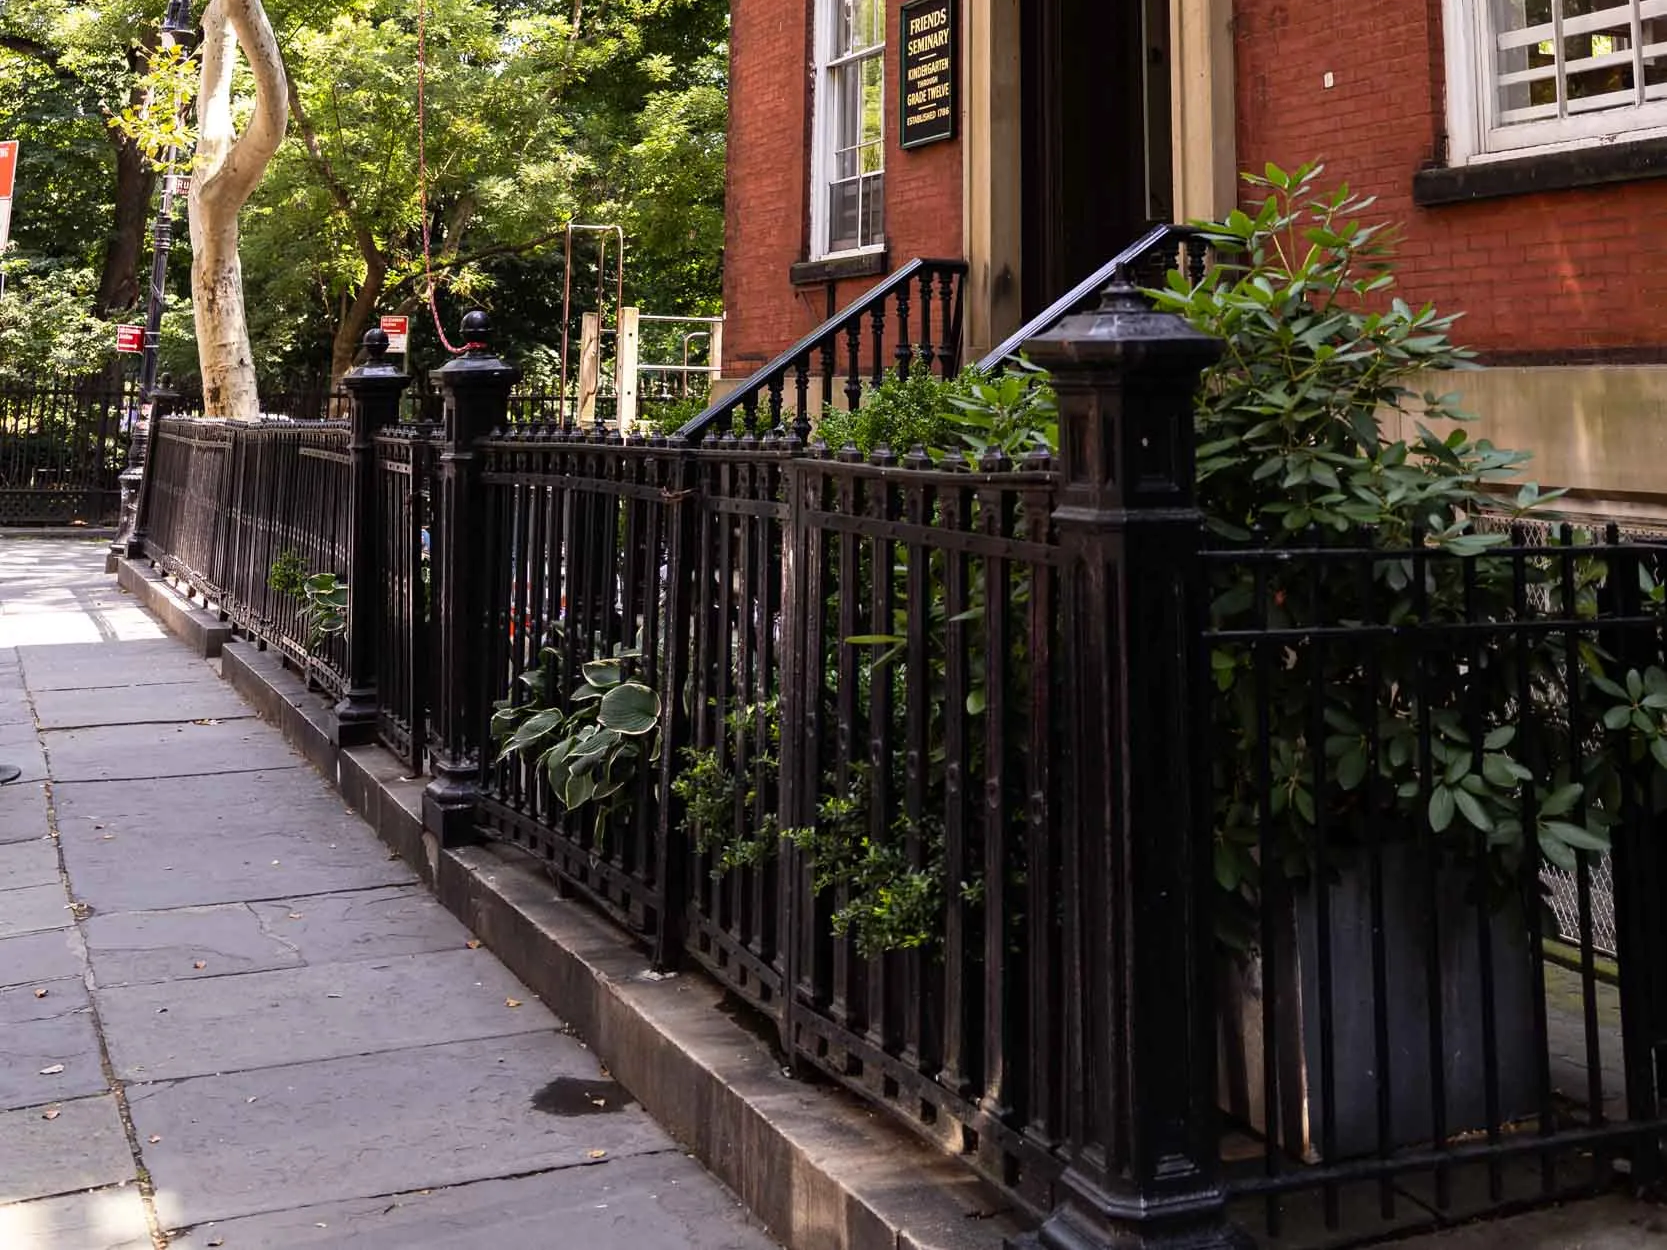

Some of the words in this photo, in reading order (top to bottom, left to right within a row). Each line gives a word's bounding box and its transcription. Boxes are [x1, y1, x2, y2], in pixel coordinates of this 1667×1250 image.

[910, 8, 947, 36] FRIENDS
[908, 28, 950, 56] SEMINARY
[908, 58, 949, 81] KINDERGARTEN
[907, 90, 927, 106] GRADE
[927, 82, 949, 100] TWELVE
